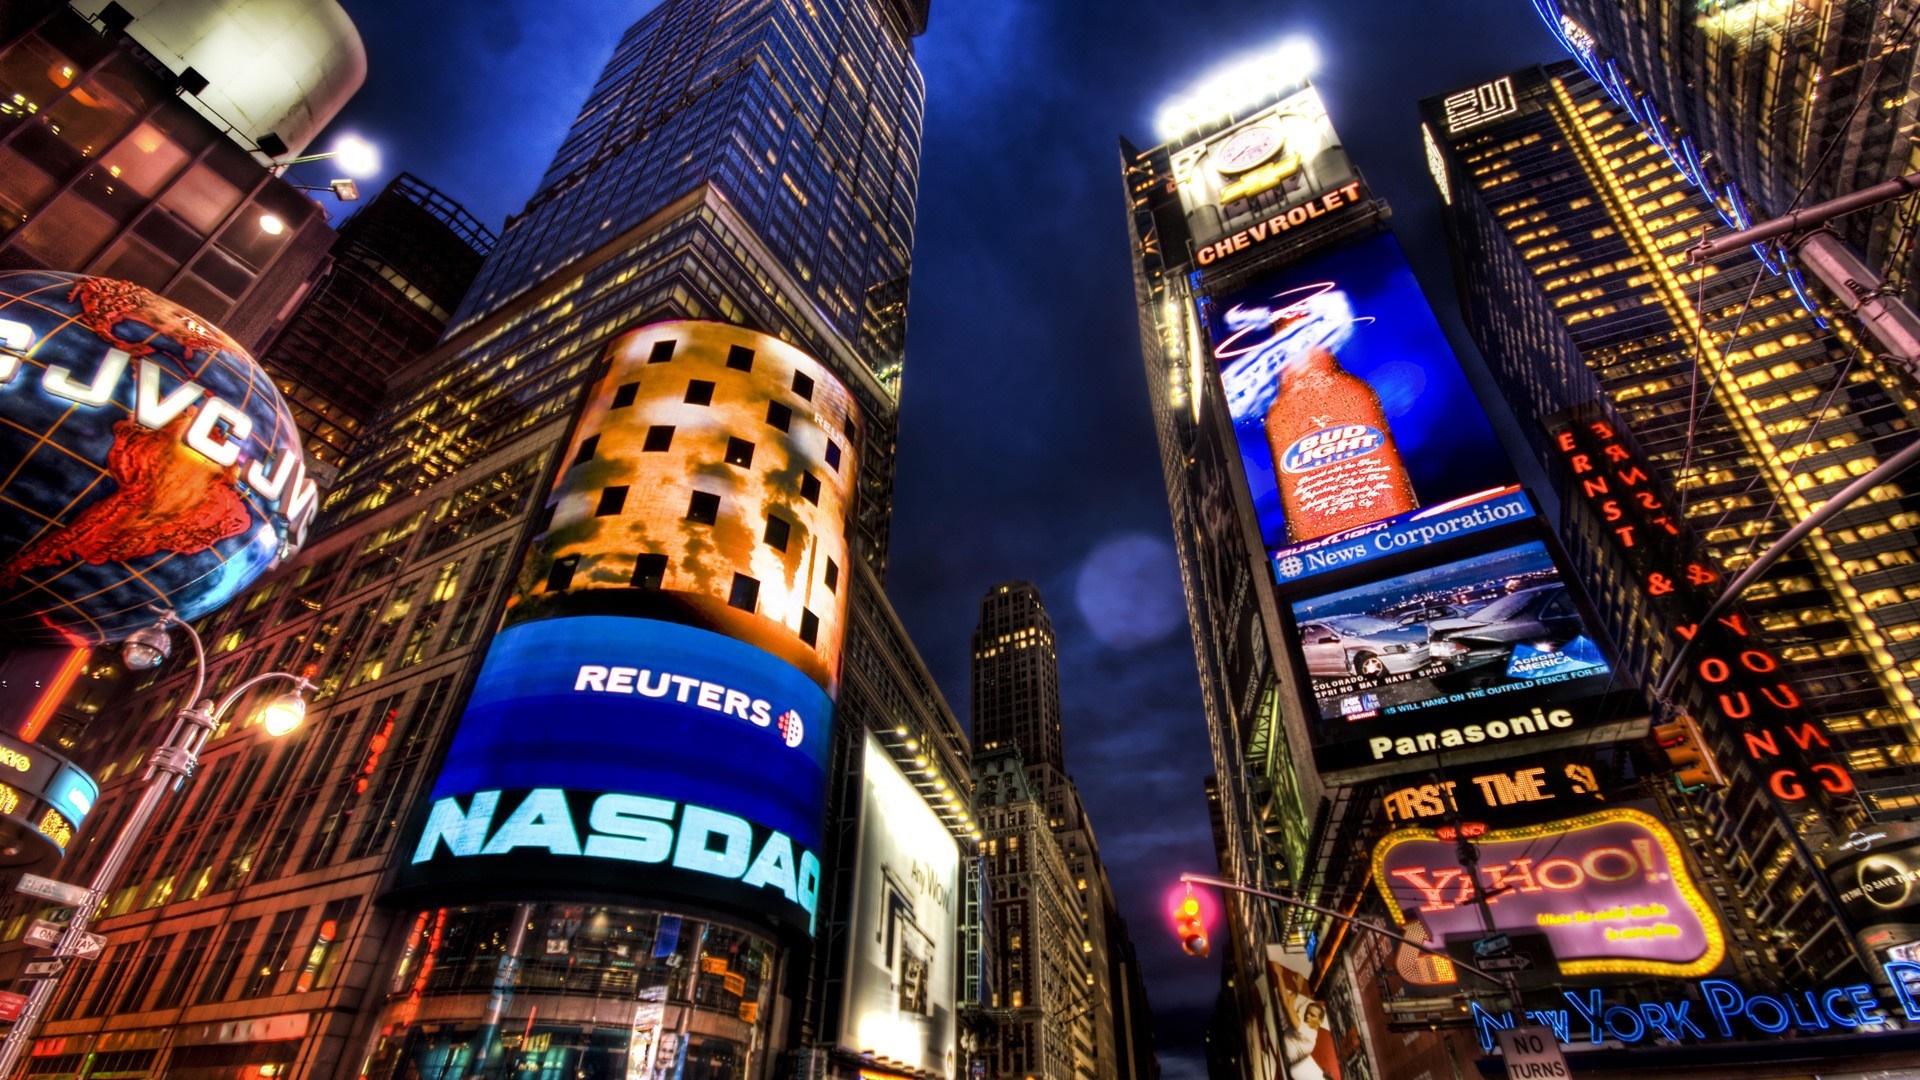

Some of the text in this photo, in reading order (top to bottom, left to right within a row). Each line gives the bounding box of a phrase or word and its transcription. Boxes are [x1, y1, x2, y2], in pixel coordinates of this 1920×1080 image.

[1197, 181, 1360, 265] CHEVROLET
[42, 347, 253, 467] JVC
[1290, 435, 1378, 470] LIGHT
[1298, 425, 1367, 453] BUD
[1558, 432, 1635, 547] ERNST
[1648, 572, 1675, 596] &
[1307, 543, 1367, 571] News
[1373, 500, 1527, 552] Corporation
[1510, 656, 1574, 674] AMERICA
[1514, 651, 1565, 666] ACROSS
[574, 665, 772, 728] REUTERS
[1313, 676, 1368, 692] COLORADO.
[1359, 680, 1378, 690] MAY
[1385, 673, 1412, 684] HAVE
[1398, 702, 1420, 713] WILL
[1422, 697, 1448, 708] HANG
[1450, 693, 1465, 703] ON
[1466, 689, 1486, 700] THE
[1487, 680, 1534, 696] OUTFIELD
[1536, 673, 1569, 687] FENCE
[1571, 668, 1593, 680] FOR
[1369, 707, 1574, 759] Panasonic
[1383, 780, 1459, 822] FIRST
[1472, 767, 1556, 807] TIME
[1438, 823, 1487, 840] VACNCY
[411, 788, 820, 938] NASDAQ
[1391, 838, 1657, 912] YAHOO!
[1872, 876, 1897, 891] SAVE
[39, 929, 96, 950] ONE AY
[1471, 1001, 1569, 1050] NW
[1563, 988, 1706, 1045] YORK
[1700, 979, 1885, 1037] POLICE
[1513, 1034, 1543, 1056] NO
[1510, 1061, 1566, 1080] TURNS
